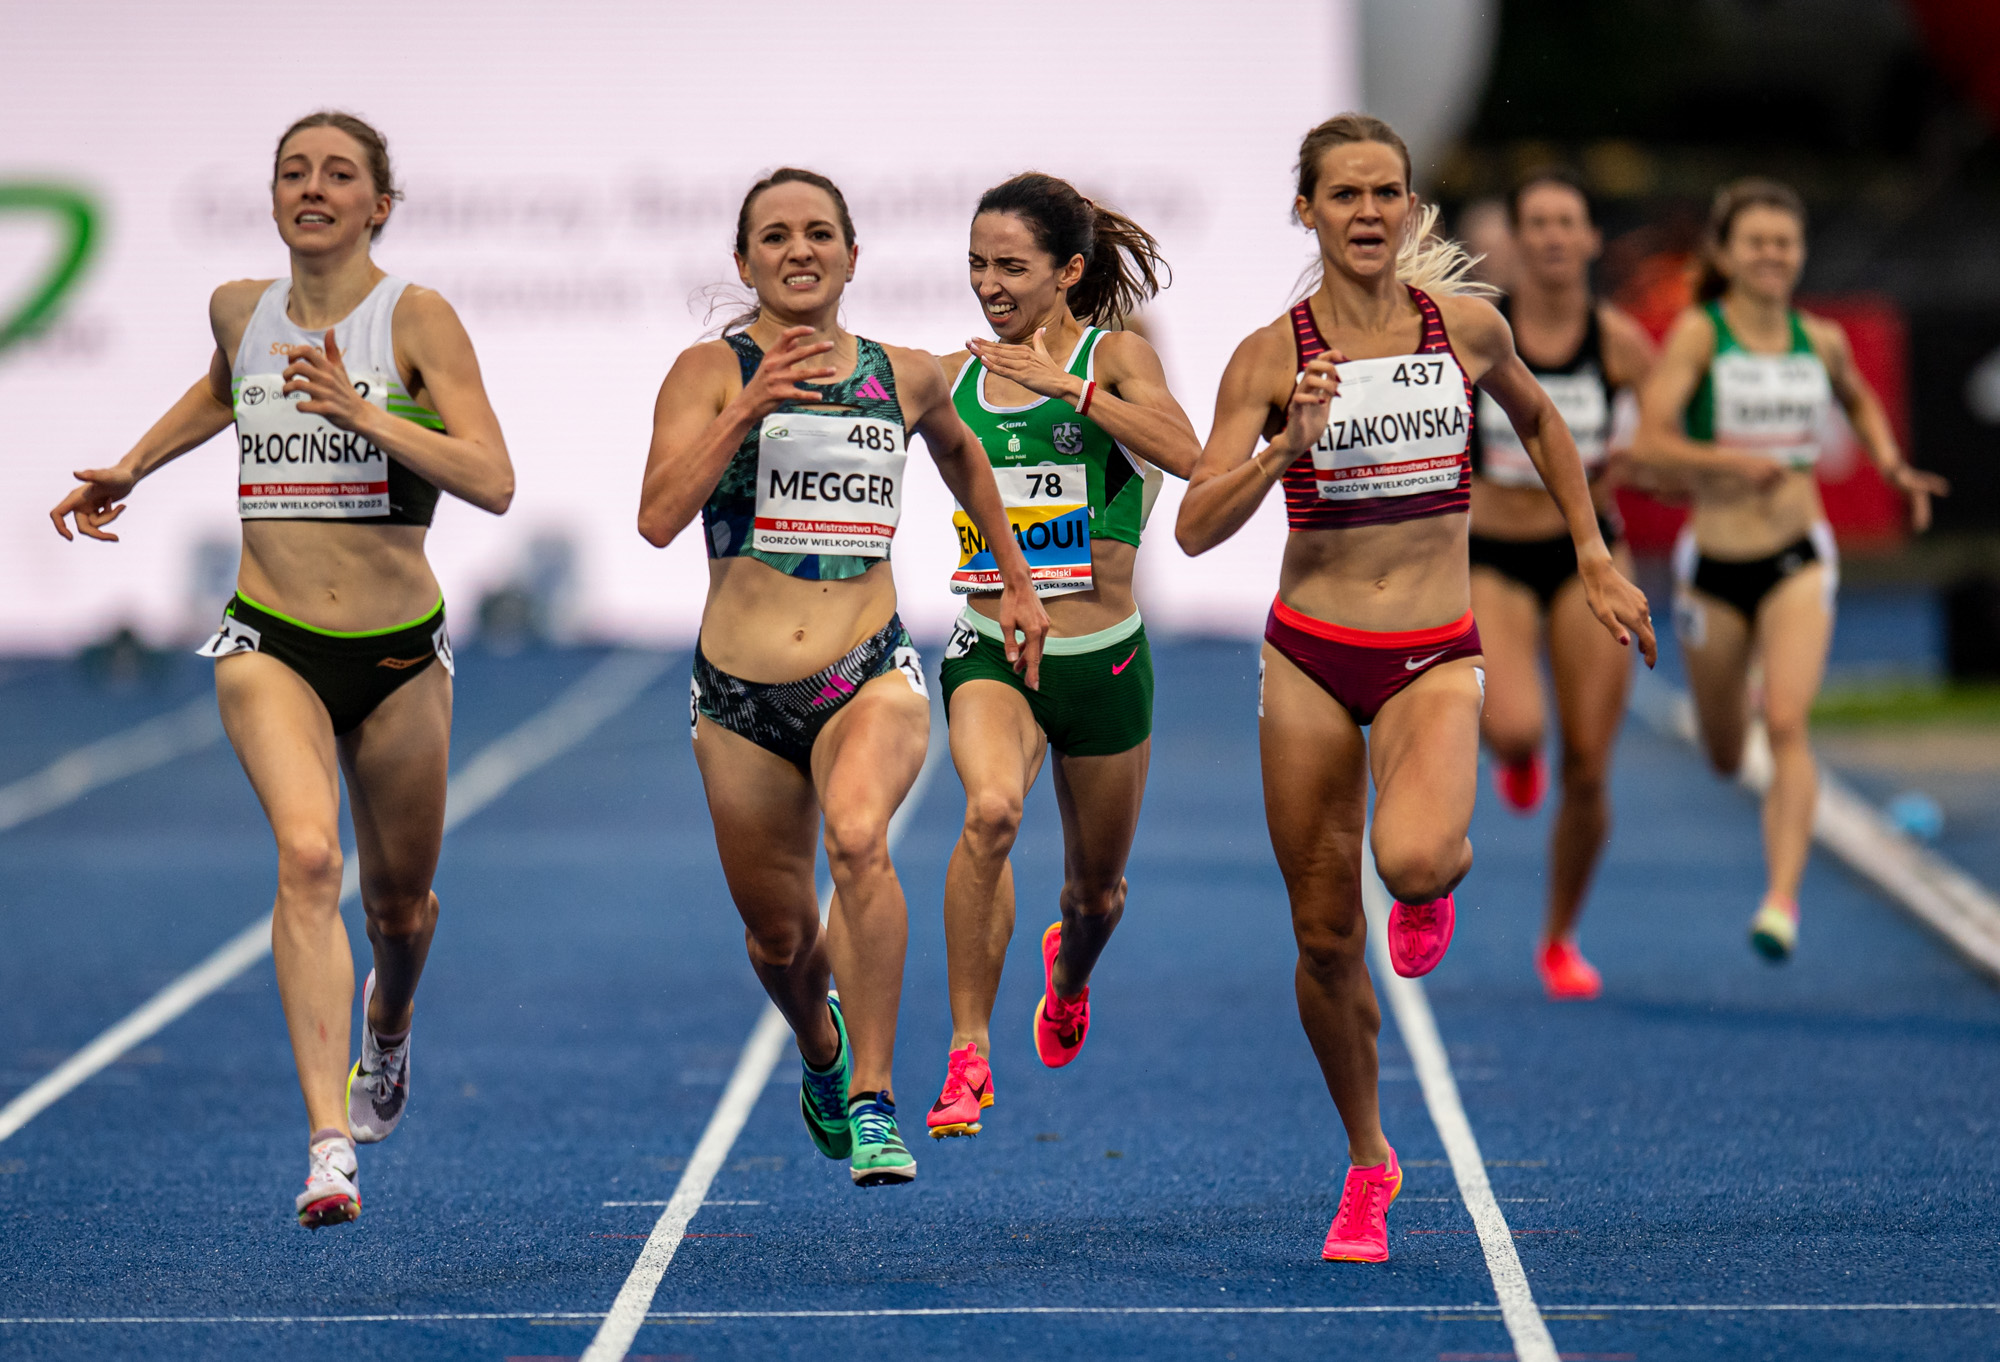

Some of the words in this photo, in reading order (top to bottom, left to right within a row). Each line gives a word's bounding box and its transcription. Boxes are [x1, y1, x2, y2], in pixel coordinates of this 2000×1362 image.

[1392, 361, 1444, 388] 437
[241, 426, 383, 465] PŁOCIŃSKA
[847, 424, 895, 453] 485
[1334, 471, 1349, 479] 99.
[1351, 469, 1374, 478] PZLA
[1375, 461, 1429, 475] Mistrzostwa
[1430, 456, 1457, 469] Polski
[264, 484, 282, 495] PZLA
[284, 484, 339, 495] Mistrzostwa
[340, 484, 369, 494] Polski
[769, 469, 895, 508] MEGGER
[1026, 473, 1063, 499] 78
[1323, 481, 1370, 494] GORZÓW
[1372, 474, 1445, 490] WIELKOPOLSKI
[242, 501, 278, 511] GORZÓW
[281, 501, 355, 510] WIELKOPOLSKI
[358, 499, 383, 509] 2023
[775, 520, 790, 530] 99.
[791, 521, 813, 531] PZLA
[815, 522, 871, 534] Mistrzostwa
[872, 525, 892, 536] Polski
[761, 535, 809, 546] GORZÓW
[811, 538, 884, 549] WIELKOPOLSKI
[1045, 568, 1072, 577] Polski
